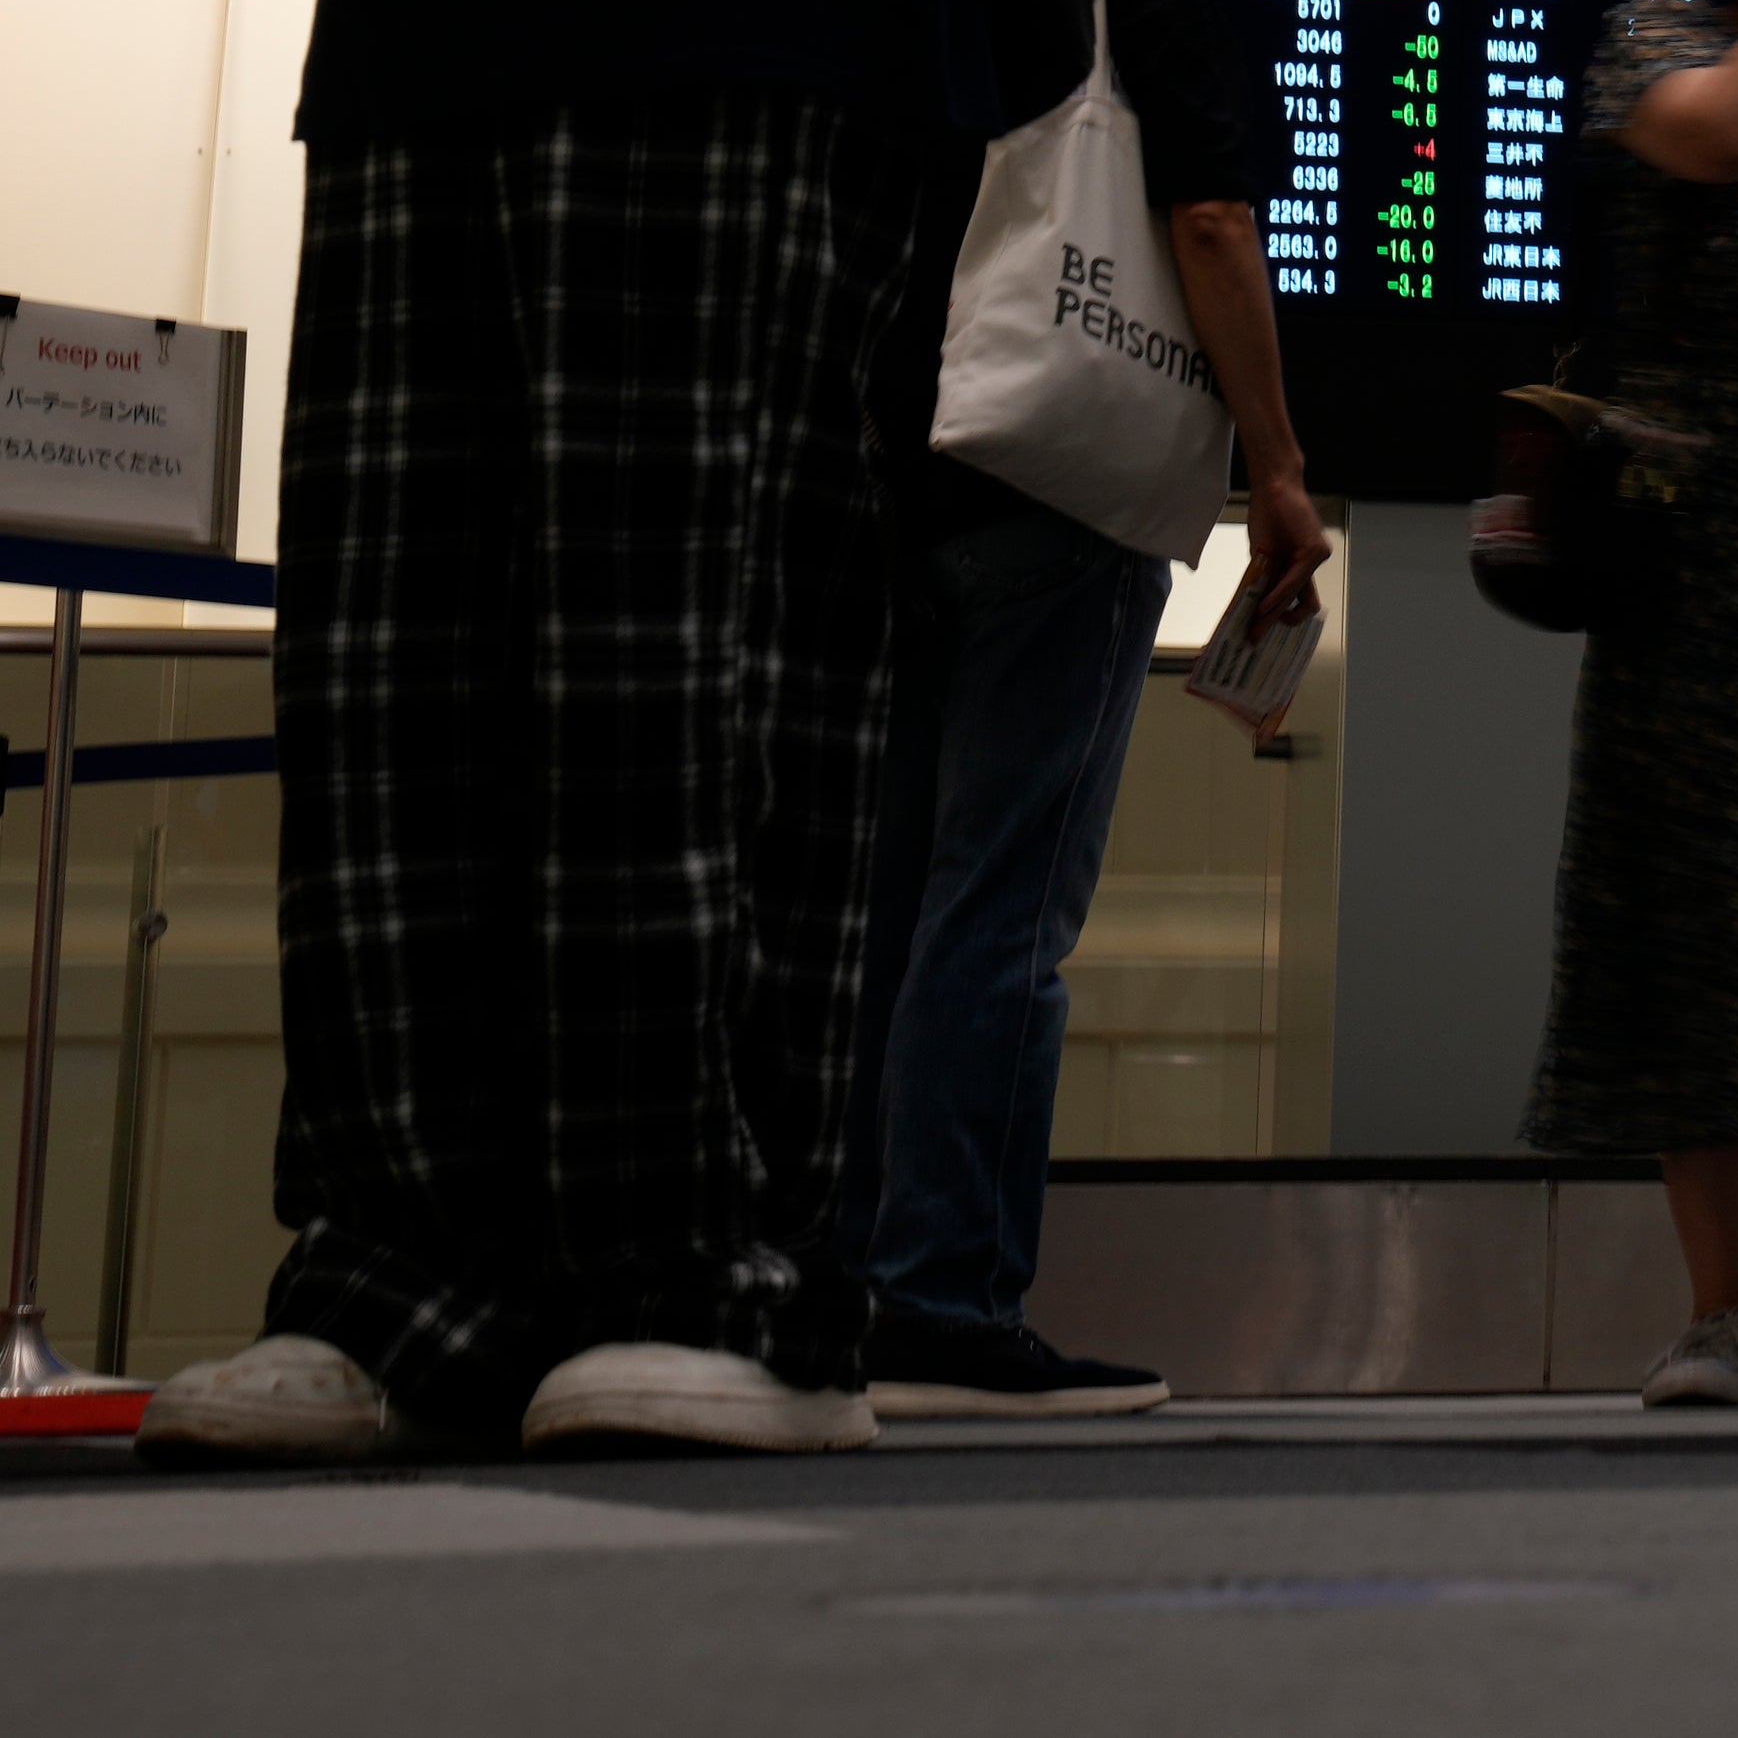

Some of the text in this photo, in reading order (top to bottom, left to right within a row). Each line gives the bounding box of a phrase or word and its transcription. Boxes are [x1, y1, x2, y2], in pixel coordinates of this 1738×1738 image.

[1487, 73, 1565, 100] 第一生命
[1062, 242, 1114, 298] BE
[1482, 243, 1562, 270] JR東日本
[1481, 277, 1562, 304] JR西日本
[38, 336, 142, 373] Keep out
